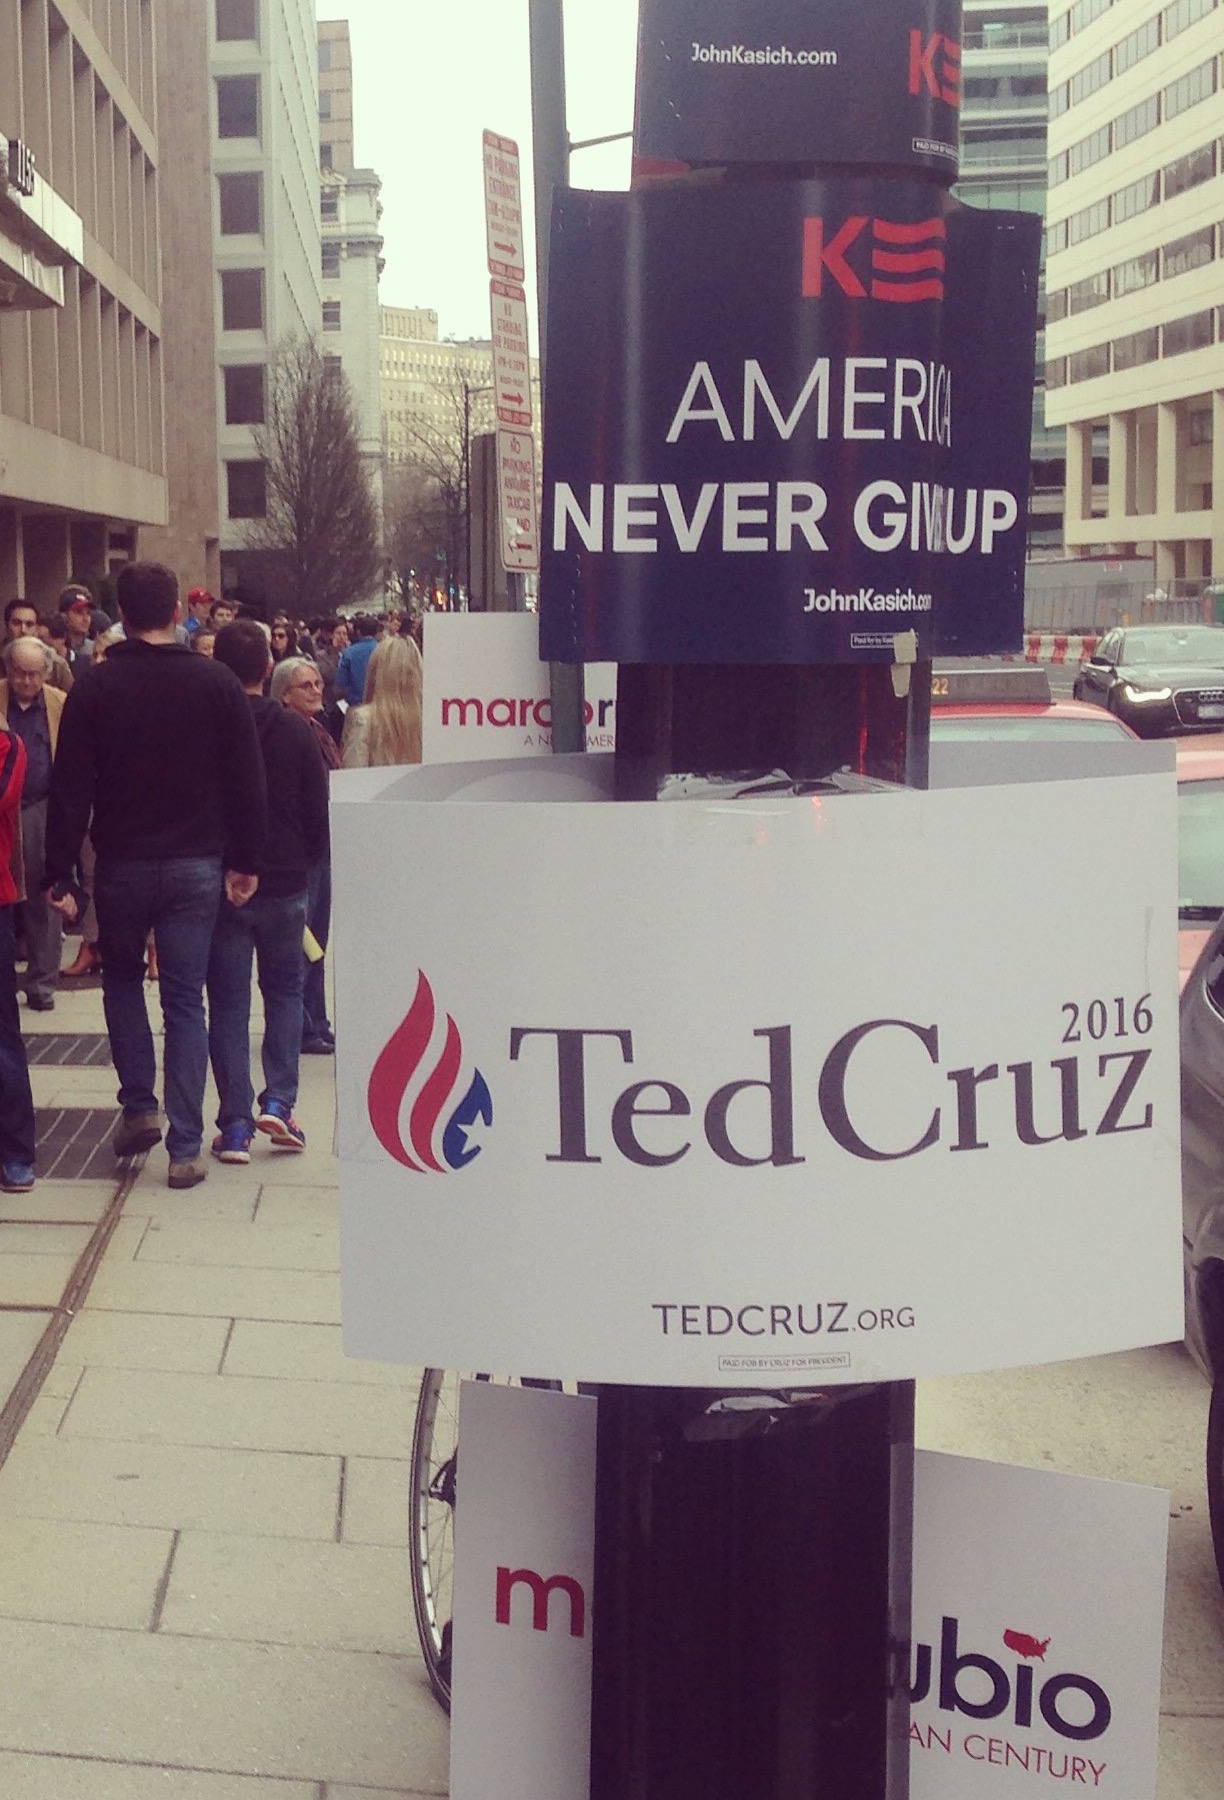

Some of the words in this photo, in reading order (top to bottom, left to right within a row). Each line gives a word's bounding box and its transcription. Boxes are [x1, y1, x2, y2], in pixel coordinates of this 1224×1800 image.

[690, 42, 837, 66] JohnKasich.com
[666, 357, 951, 447] AMERICA
[552, 481, 829, 553] NEVER
[946, 488, 1017, 554] UP
[1061, 993, 1154, 1045] 2016
[652, 1302, 915, 1336] TEDCRUZ.ORG
[910, 1616, 1112, 1741] bio
[964, 1734, 1108, 1787] CENTURY
